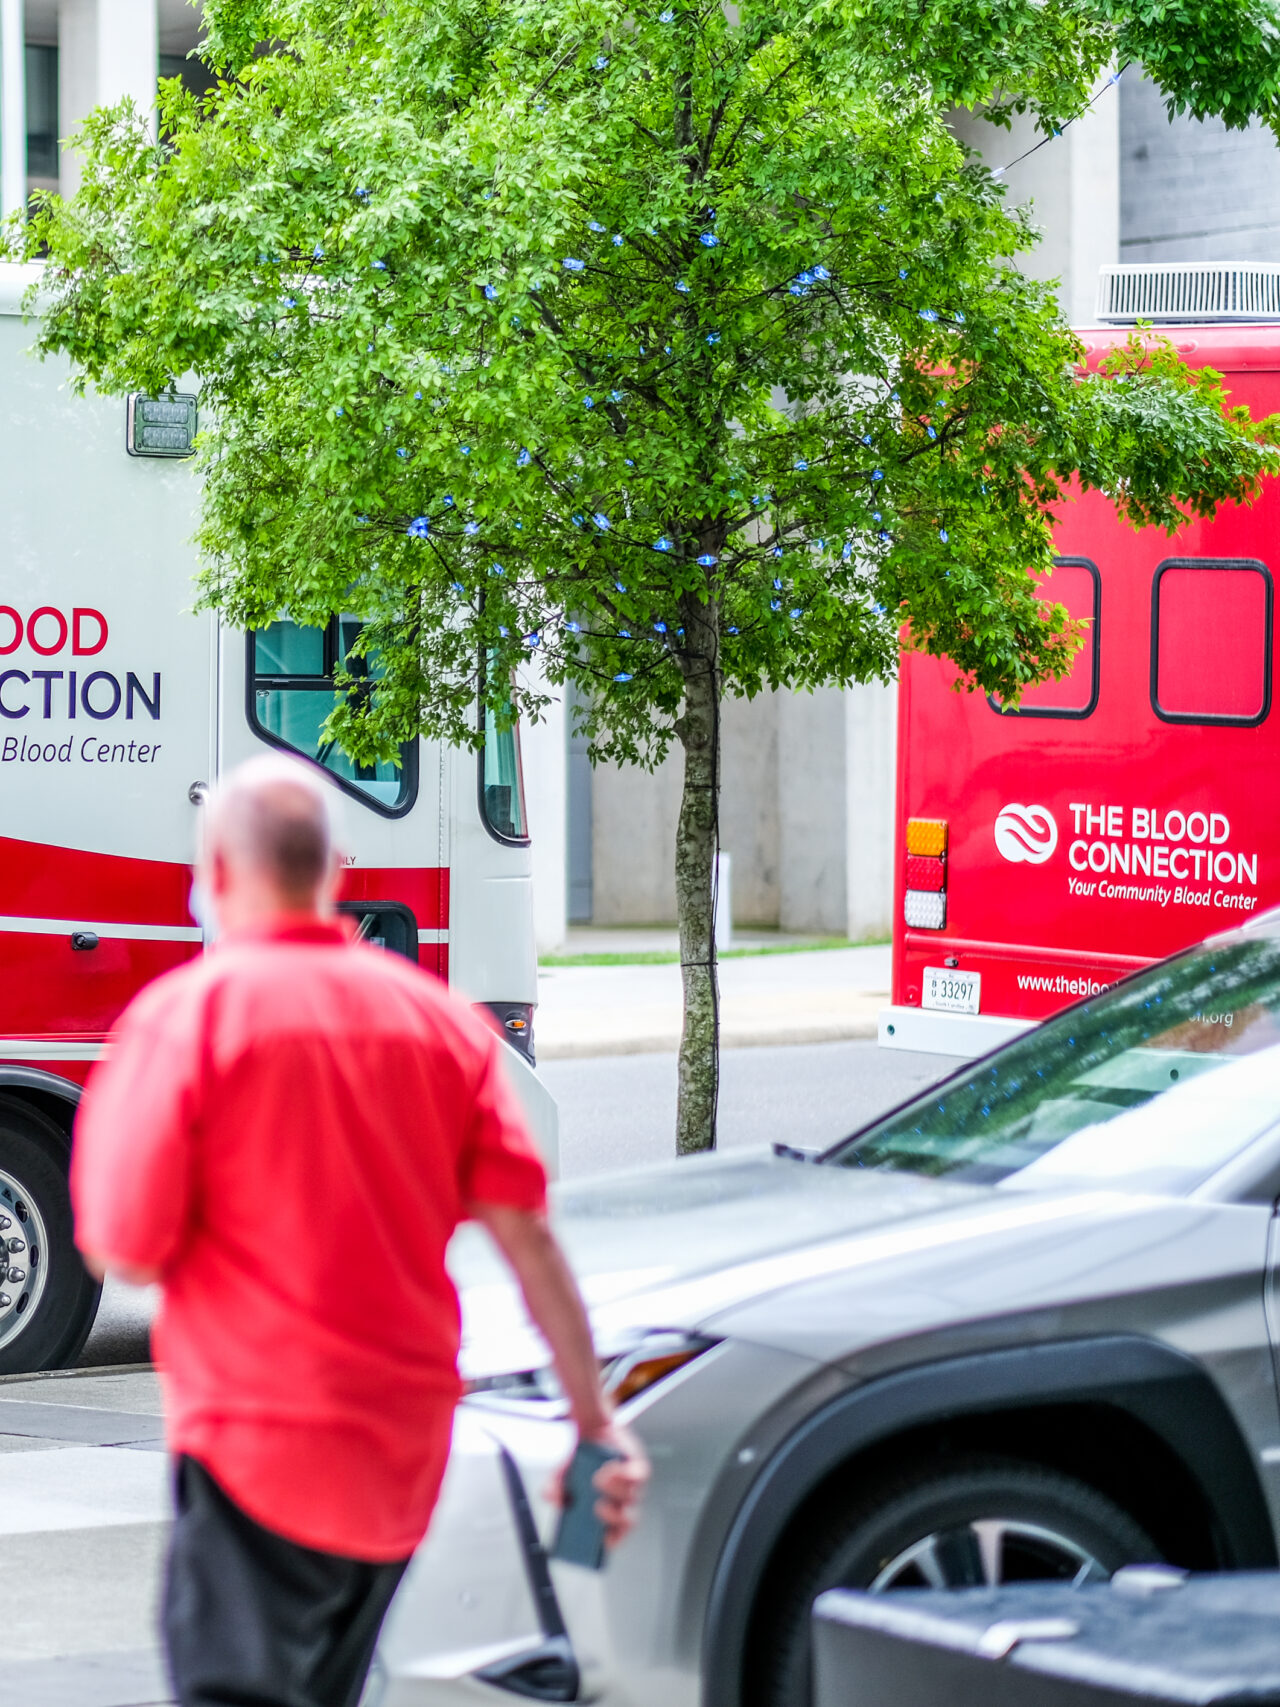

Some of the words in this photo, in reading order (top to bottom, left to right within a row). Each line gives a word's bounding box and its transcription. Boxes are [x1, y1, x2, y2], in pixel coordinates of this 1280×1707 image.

[1, 735, 74, 762] Blood
[80, 737, 161, 763] Center
[1069, 803, 1123, 837] THE
[1132, 807, 1230, 844] BLOOD
[1068, 839, 1258, 885] CONNECTION
[1068, 877, 1097, 896] Your
[1098, 879, 1171, 907] Community
[1173, 886, 1211, 907] Blood
[1213, 890, 1258, 910] Center
[940, 980, 974, 1001] 33297
